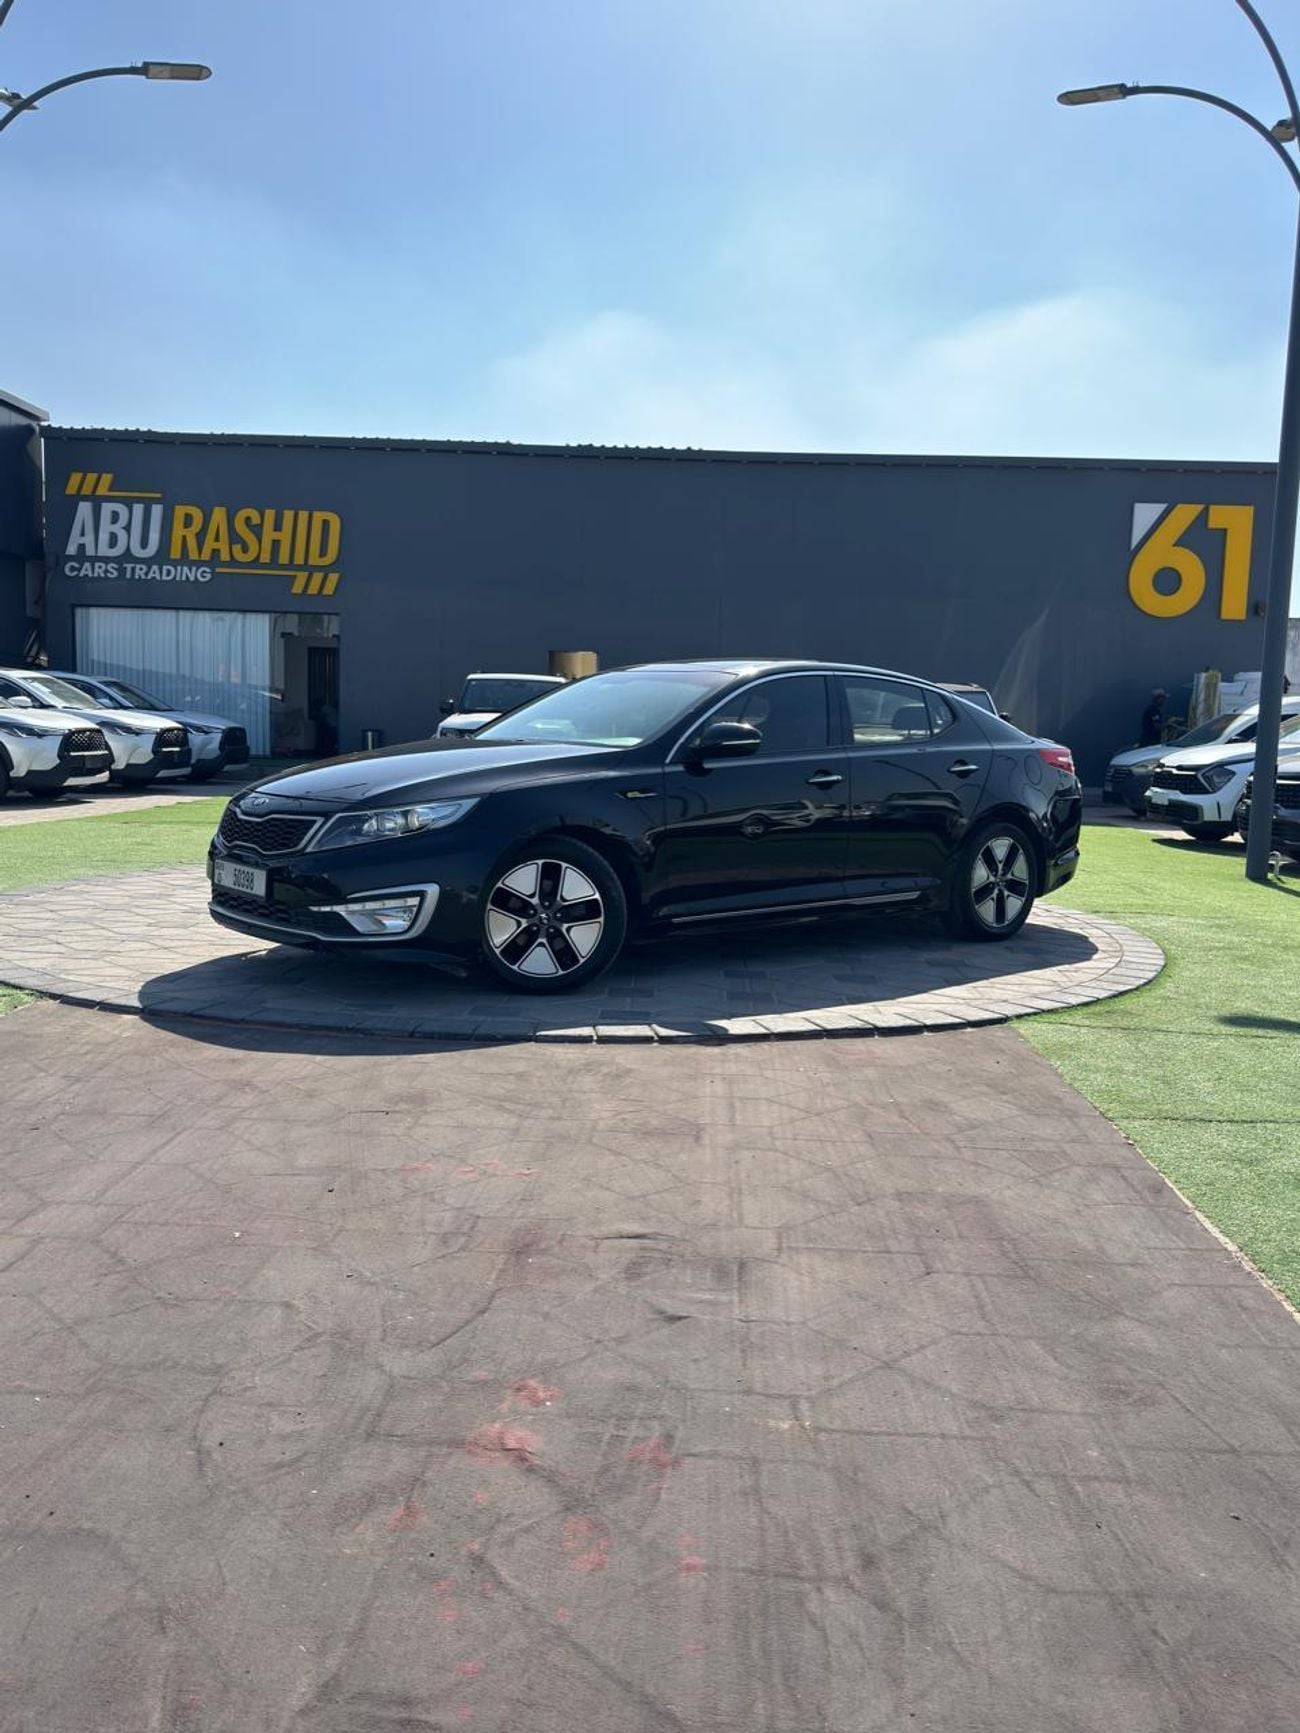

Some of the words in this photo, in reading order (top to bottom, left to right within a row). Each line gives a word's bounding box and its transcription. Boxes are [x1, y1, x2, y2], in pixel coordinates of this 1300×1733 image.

[65, 501, 164, 558] ABU
[169, 505, 342, 566] RASHID
[1128, 503, 1254, 620] 61
[64, 562, 119, 578] CARS
[123, 564, 212, 582] TRADING
